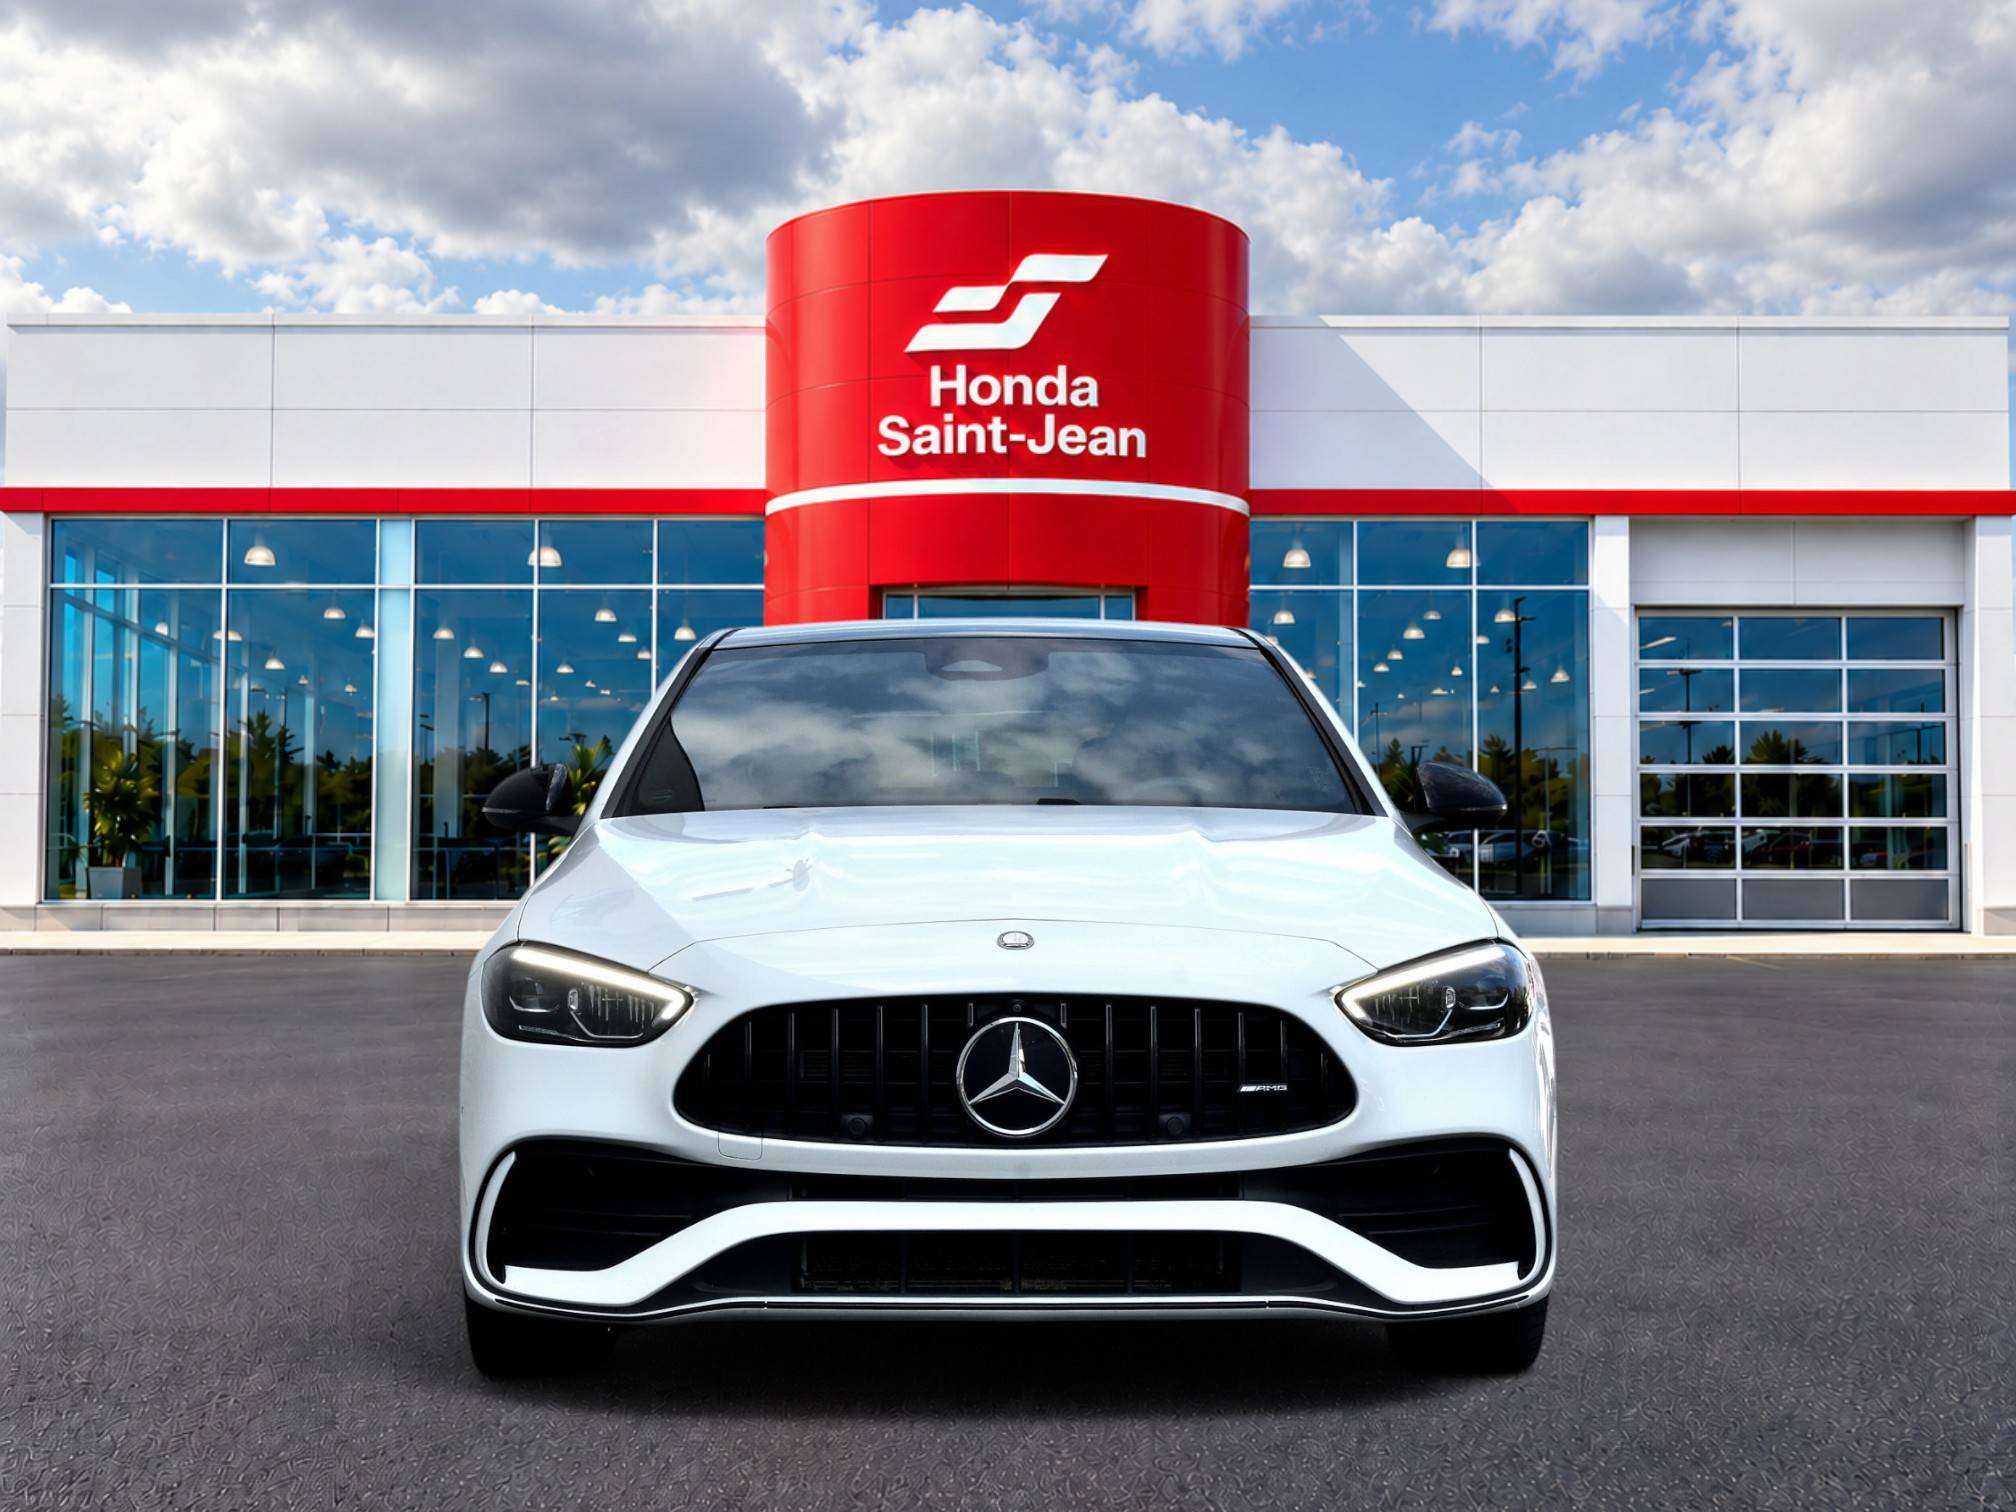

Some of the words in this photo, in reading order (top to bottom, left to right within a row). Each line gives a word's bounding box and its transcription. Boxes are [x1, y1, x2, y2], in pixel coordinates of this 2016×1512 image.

[929, 364, 1098, 407] Honda
[877, 413, 1146, 458] Saint-Jean
[1255, 1084, 1288, 1092] AMG
